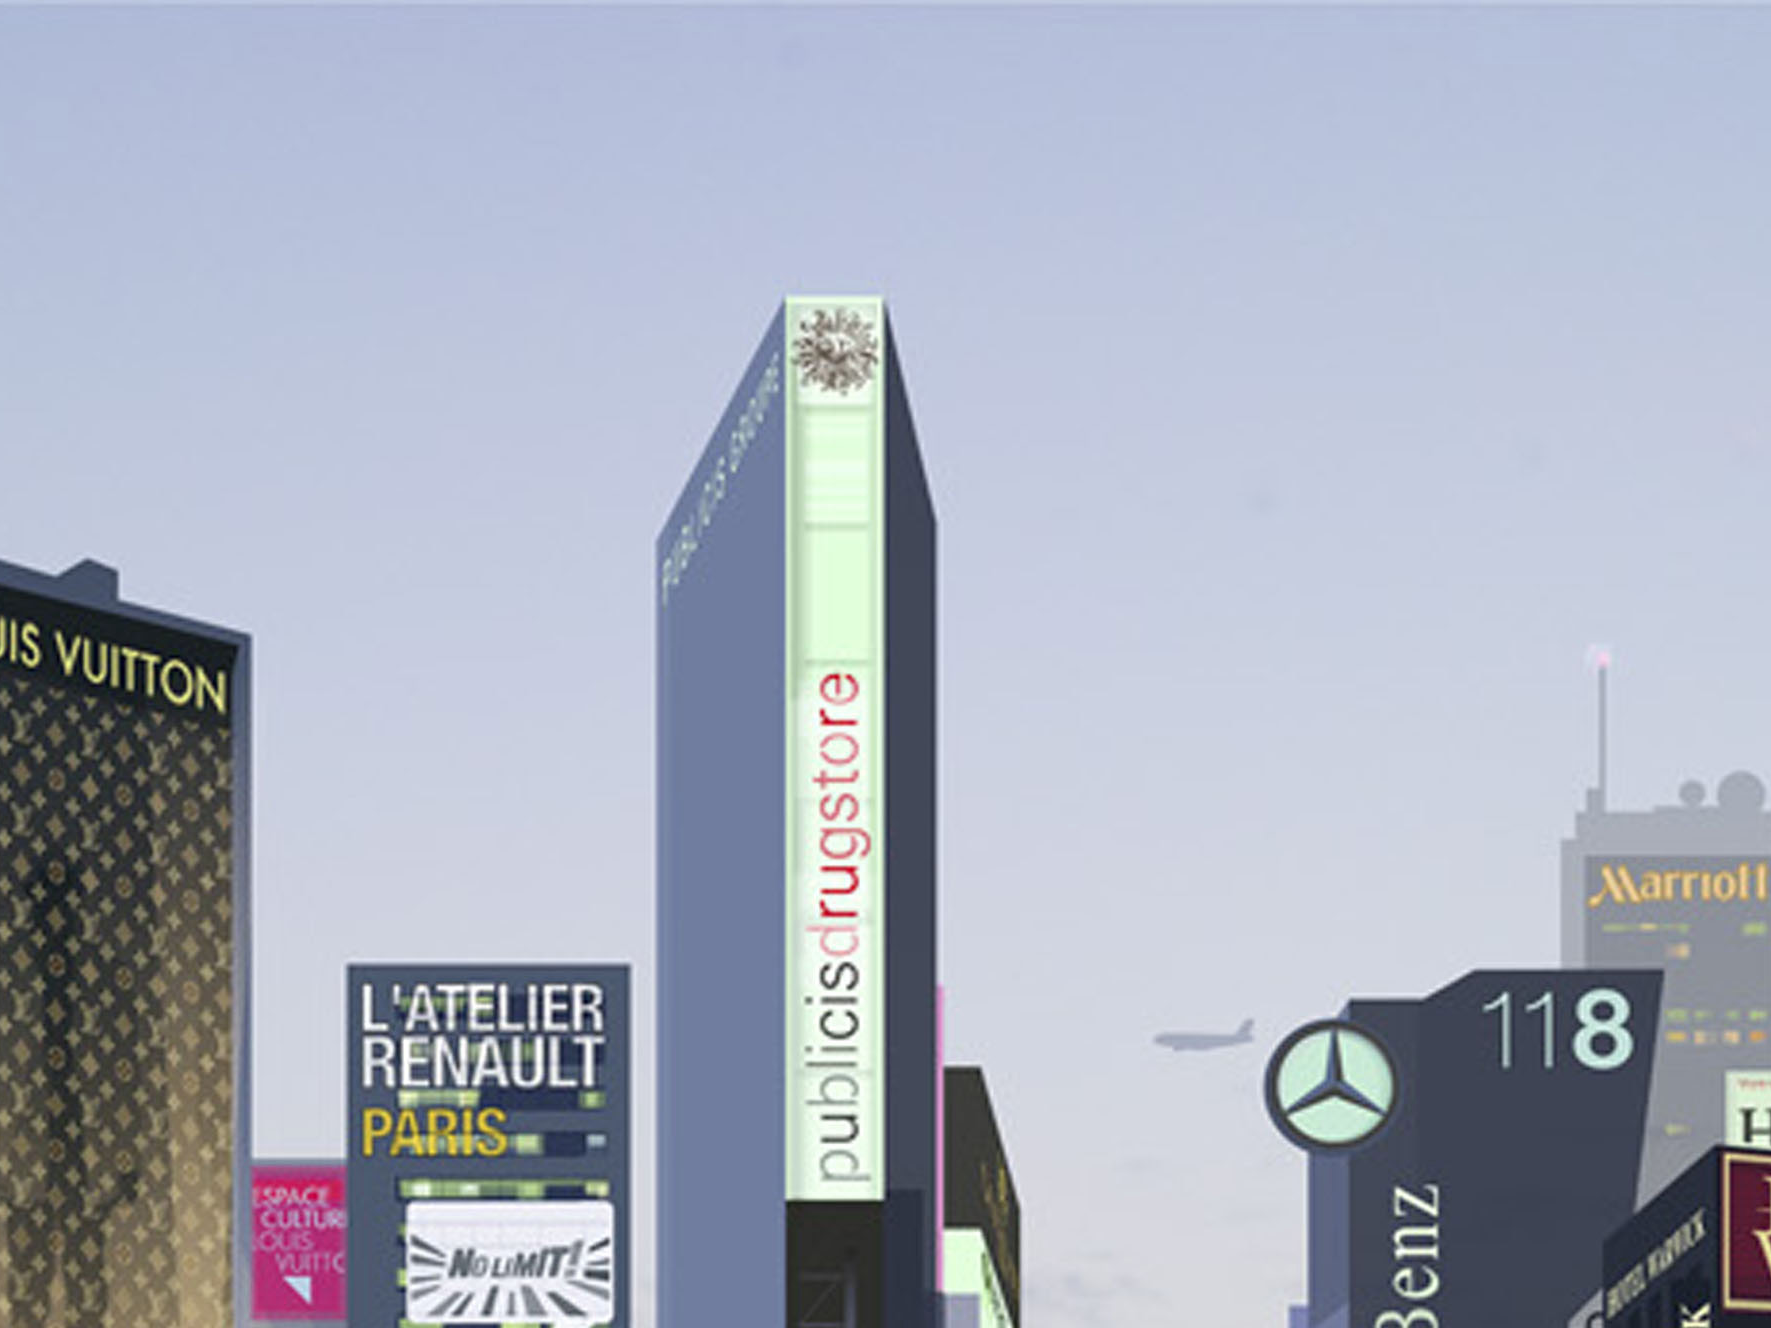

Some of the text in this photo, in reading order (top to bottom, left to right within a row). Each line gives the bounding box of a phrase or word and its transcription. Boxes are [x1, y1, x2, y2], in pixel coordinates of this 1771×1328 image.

[55, 630, 228, 714] VUITTON
[1587, 862, 1769, 908] Marriott
[805, 672, 871, 1182] publicisdrugstore
[362, 982, 605, 1033] L'ATELIER
[1481, 986, 1635, 1072] 118
[362, 1035, 606, 1088] RENAULT
[362, 1107, 509, 1157] PARIS
